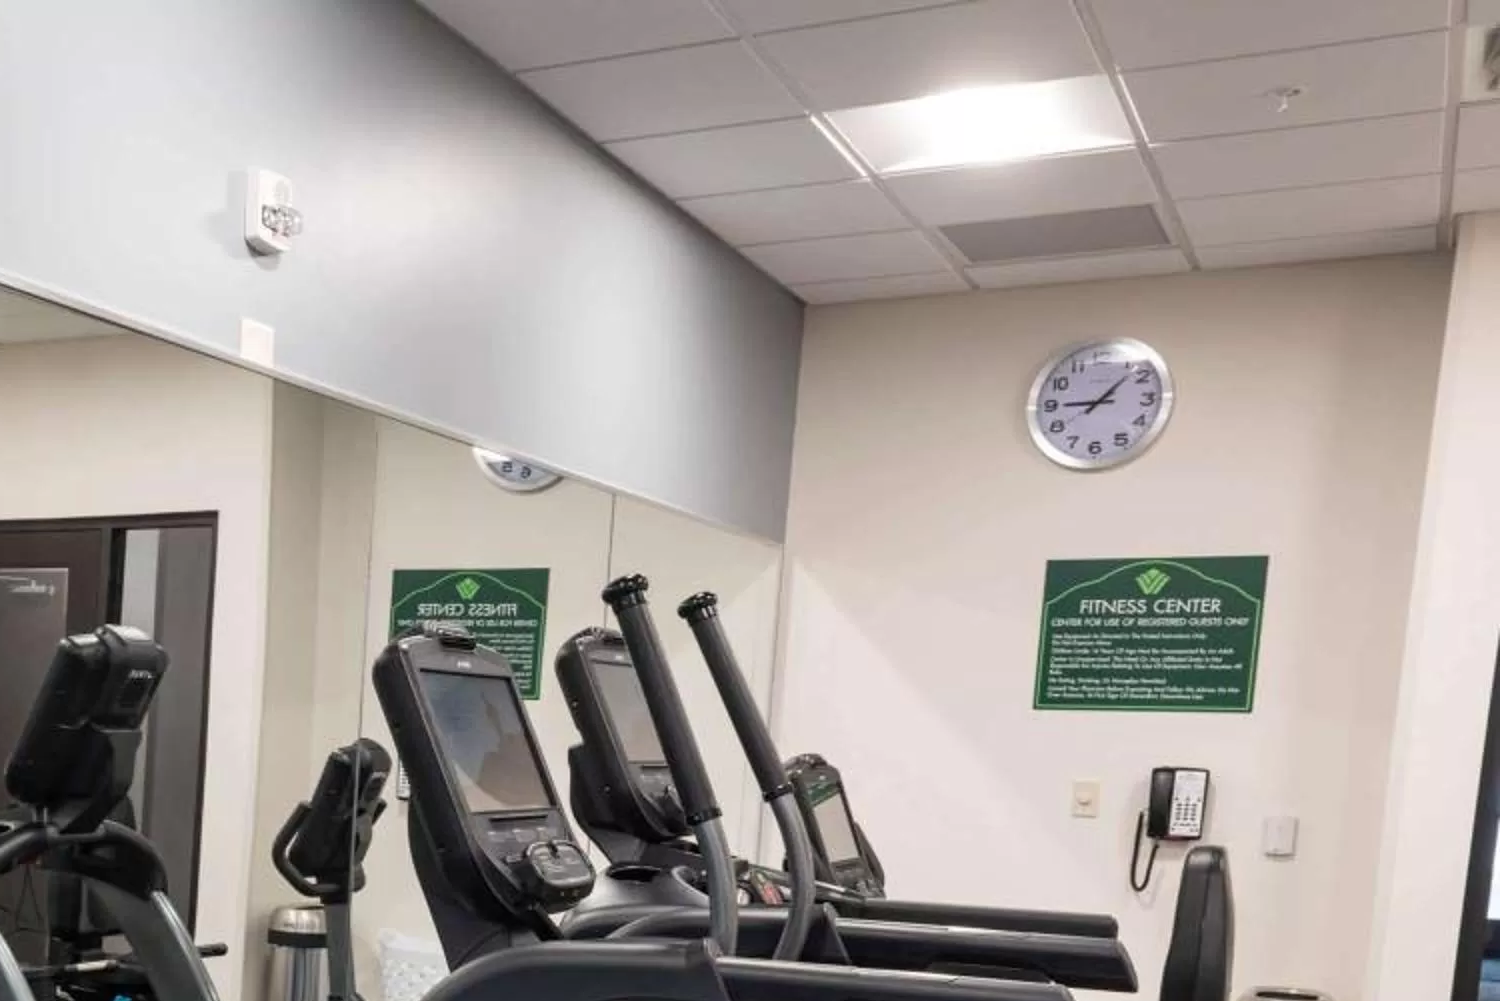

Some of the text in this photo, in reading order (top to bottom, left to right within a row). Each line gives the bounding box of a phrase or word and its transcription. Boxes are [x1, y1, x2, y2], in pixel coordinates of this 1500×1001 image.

[1071, 360, 1085, 374] 11
[1135, 369, 1151, 384] 2
[1052, 377, 1069, 391] 10
[1044, 400, 1058, 412] 9
[1140, 392, 1156, 406] 3
[1050, 420, 1065, 433] 8
[1132, 414, 1145, 426] 4
[1066, 436, 1079, 449] 7
[1114, 433, 1129, 447] 5
[1088, 441, 1102, 455] 6
[1080, 598, 1221, 615] FITNESS CENTER
